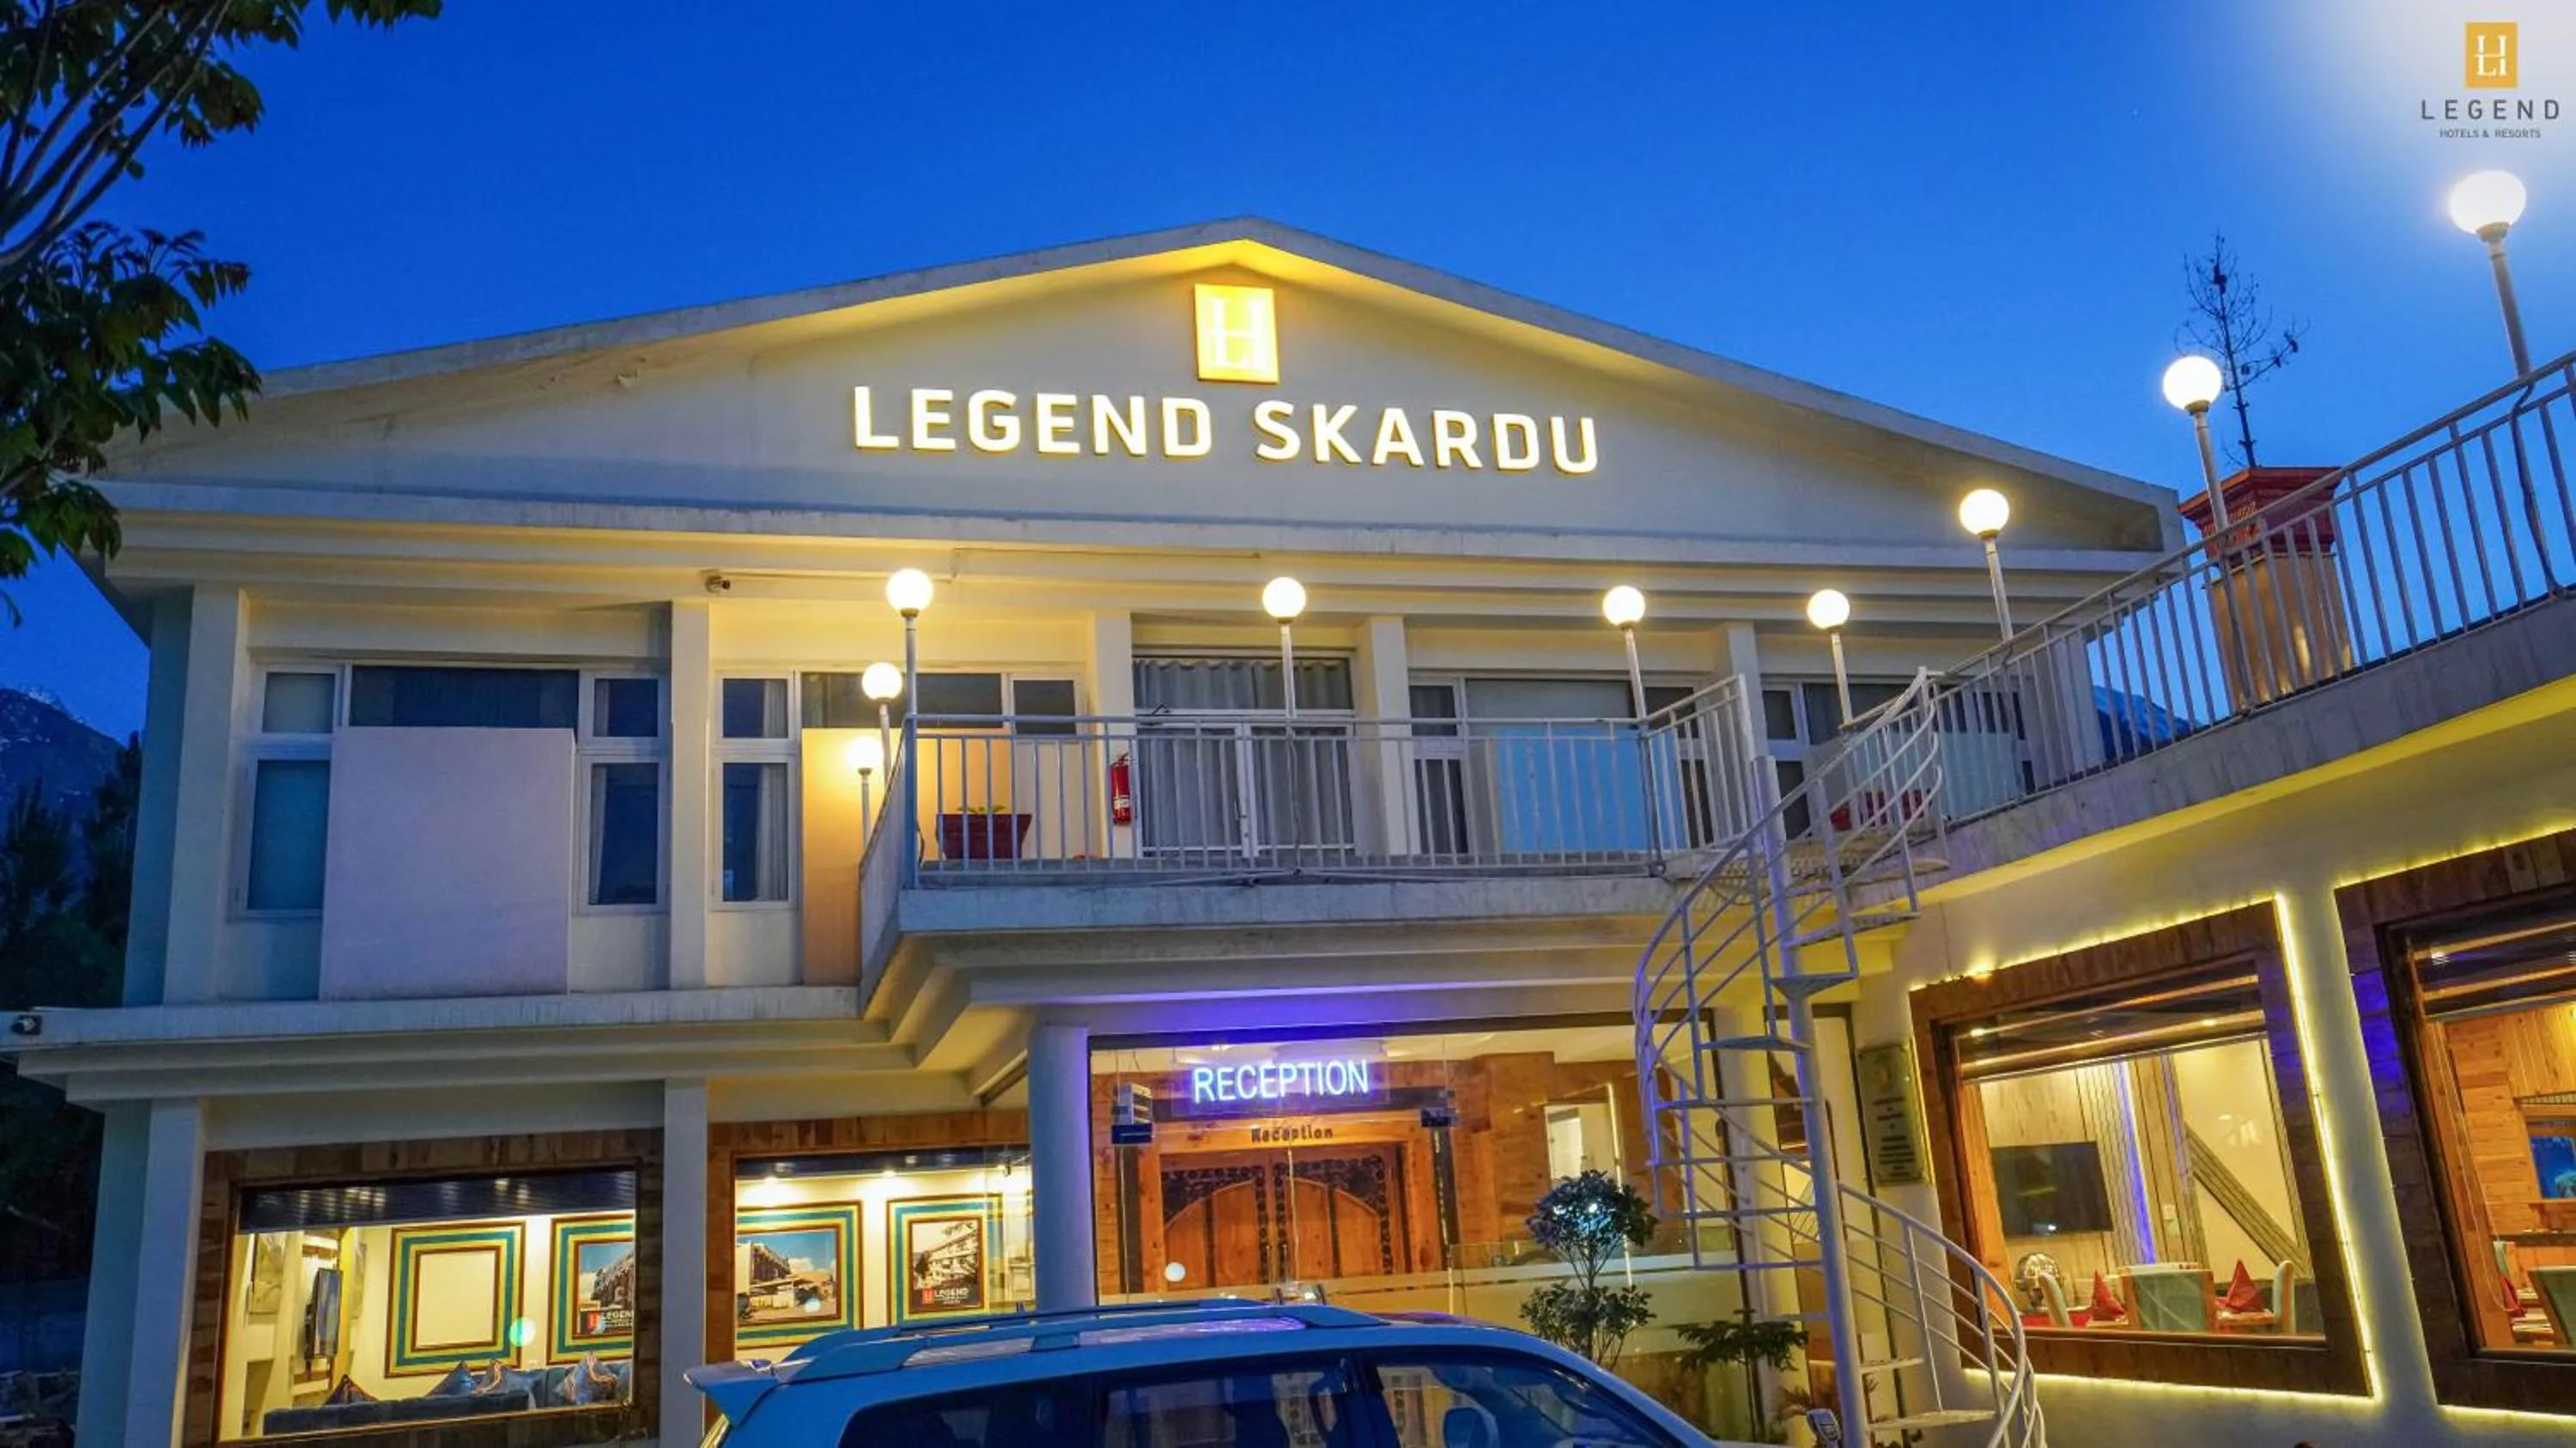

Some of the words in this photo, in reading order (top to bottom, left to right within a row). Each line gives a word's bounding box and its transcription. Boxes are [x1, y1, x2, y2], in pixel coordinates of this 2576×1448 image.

[854, 386, 1212, 457] LEGEND
[1253, 399, 1599, 474] SKARDU
[1194, 1059, 1369, 1104] RECEPTION
[1250, 1124, 1334, 1143] Reception
